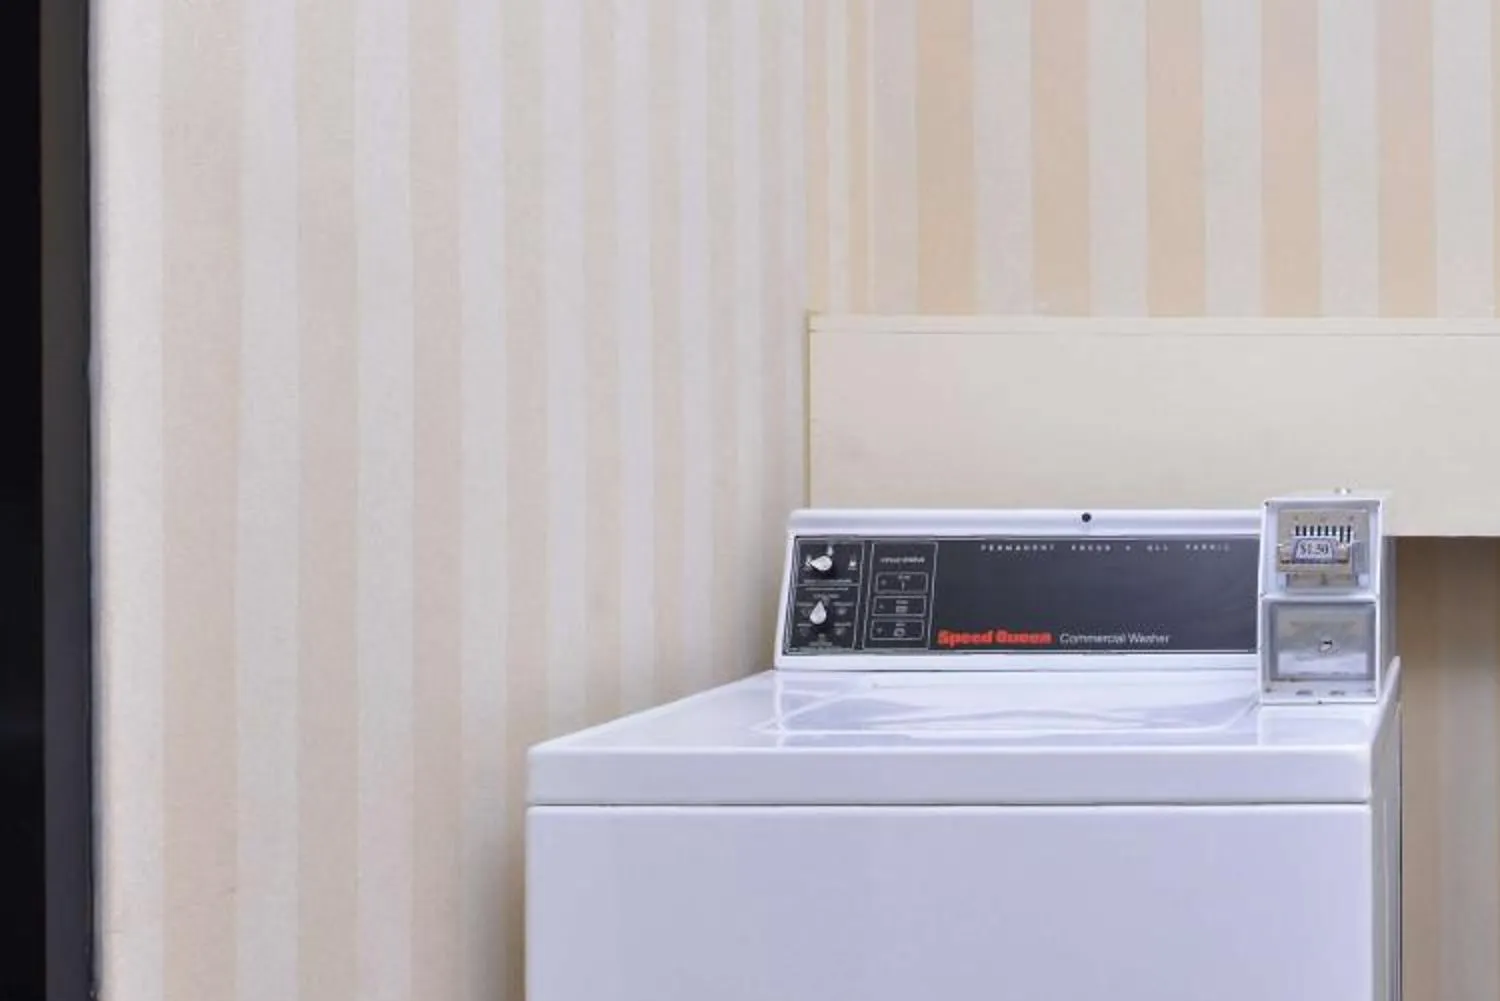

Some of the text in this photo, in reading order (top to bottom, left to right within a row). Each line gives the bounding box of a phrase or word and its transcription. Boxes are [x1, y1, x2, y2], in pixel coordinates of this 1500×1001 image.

[938, 629, 1170, 648] Speed Queen Commercial Washer
